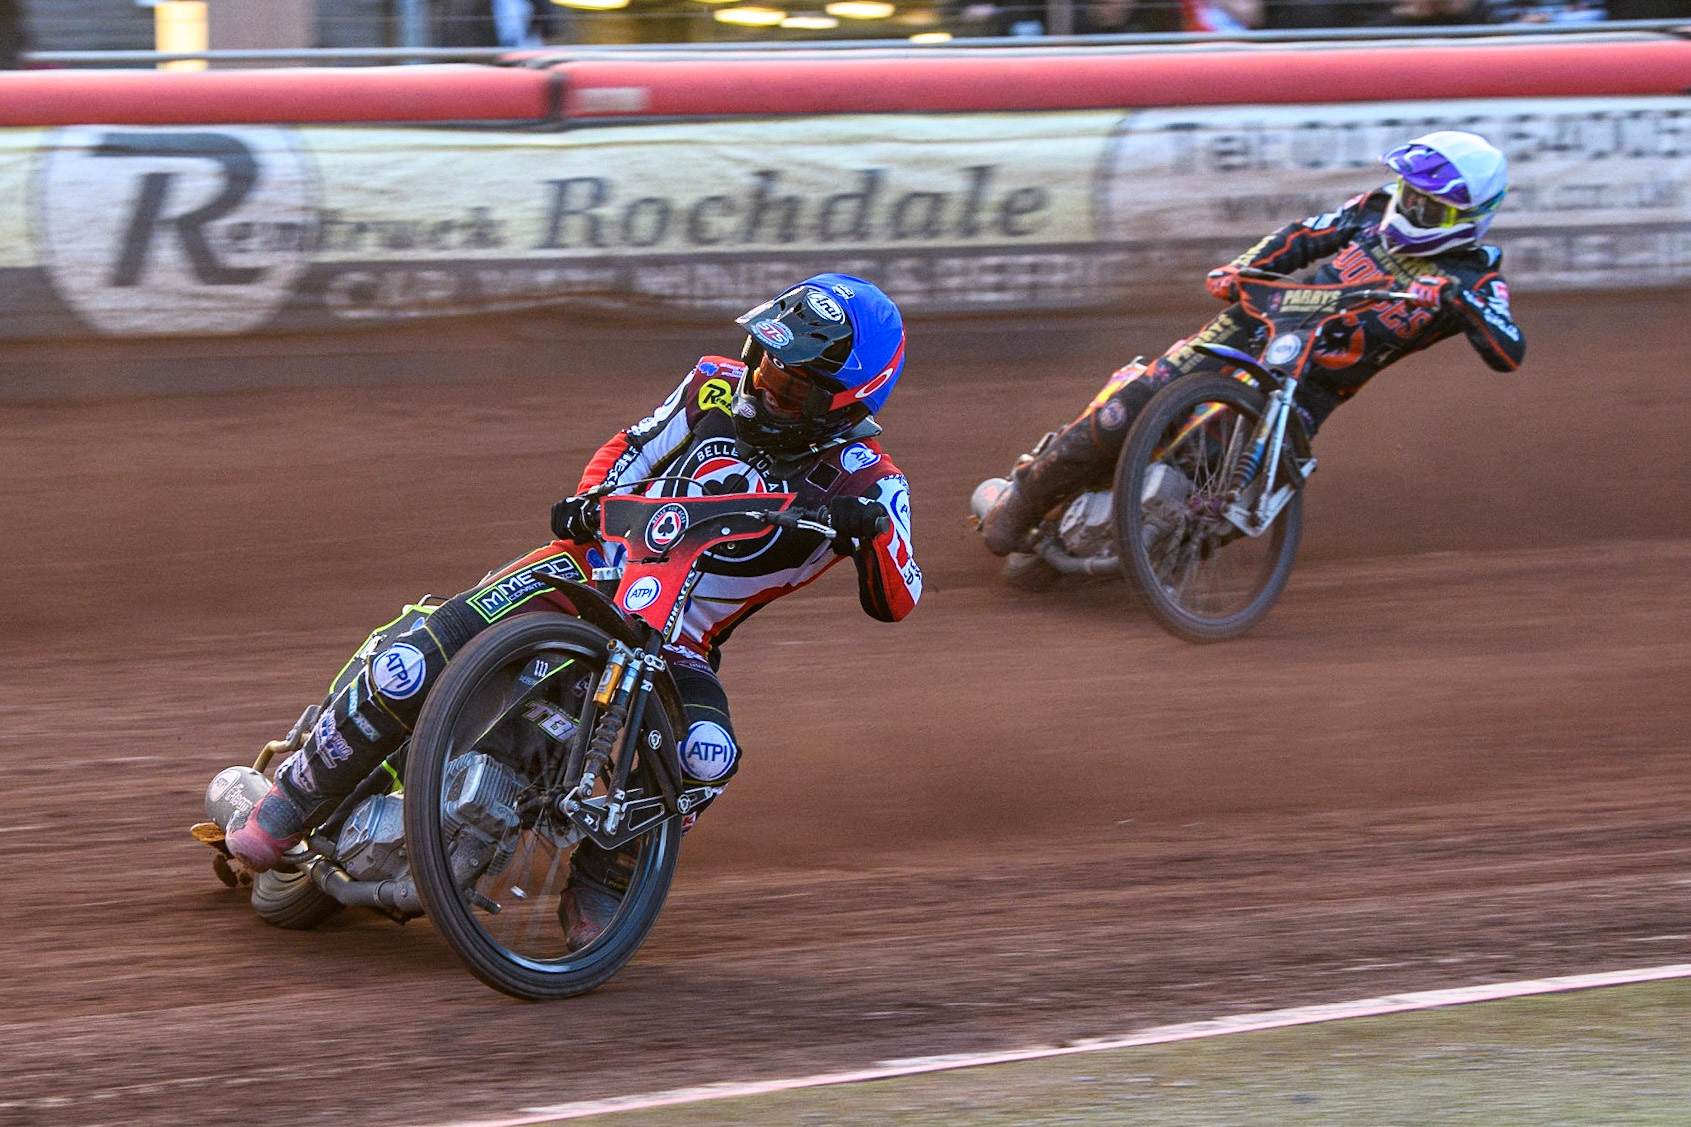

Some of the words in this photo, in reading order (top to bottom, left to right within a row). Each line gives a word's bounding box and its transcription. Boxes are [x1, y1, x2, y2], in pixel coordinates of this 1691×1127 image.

[537, 164, 1053, 249] Rochdale
[815, 297, 841, 319] Arai
[757, 322, 787, 343] STS
[696, 444, 739, 462] BELLE
[629, 587, 654, 599] ATPI
[385, 651, 412, 689] ATPI
[687, 741, 728, 763] ATPI
